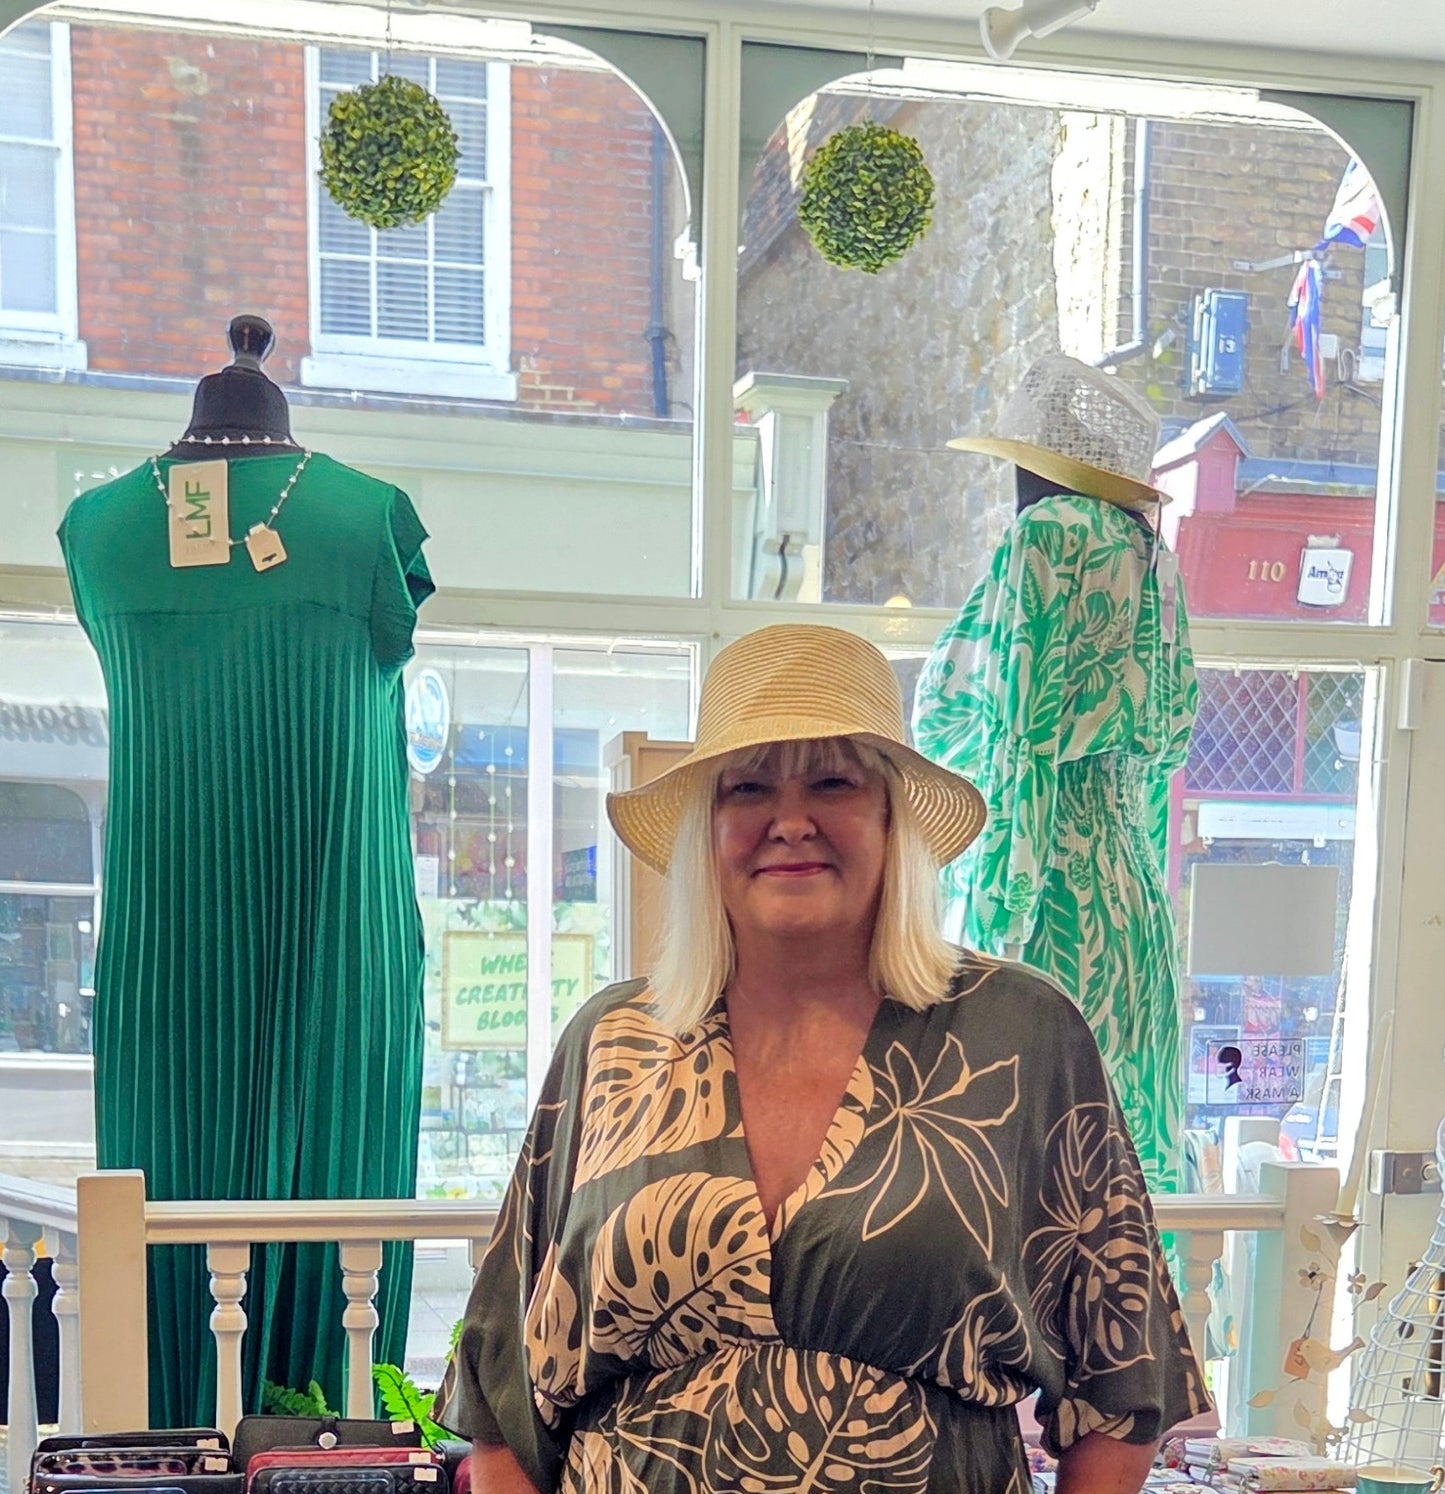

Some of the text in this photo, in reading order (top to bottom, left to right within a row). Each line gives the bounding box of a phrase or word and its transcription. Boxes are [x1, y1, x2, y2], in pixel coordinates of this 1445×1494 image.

[185, 480, 212, 539] LMF
[1248, 560, 1286, 582] 110
[481, 953, 554, 976] WHE
[476, 1006, 560, 1031] BLOOS
